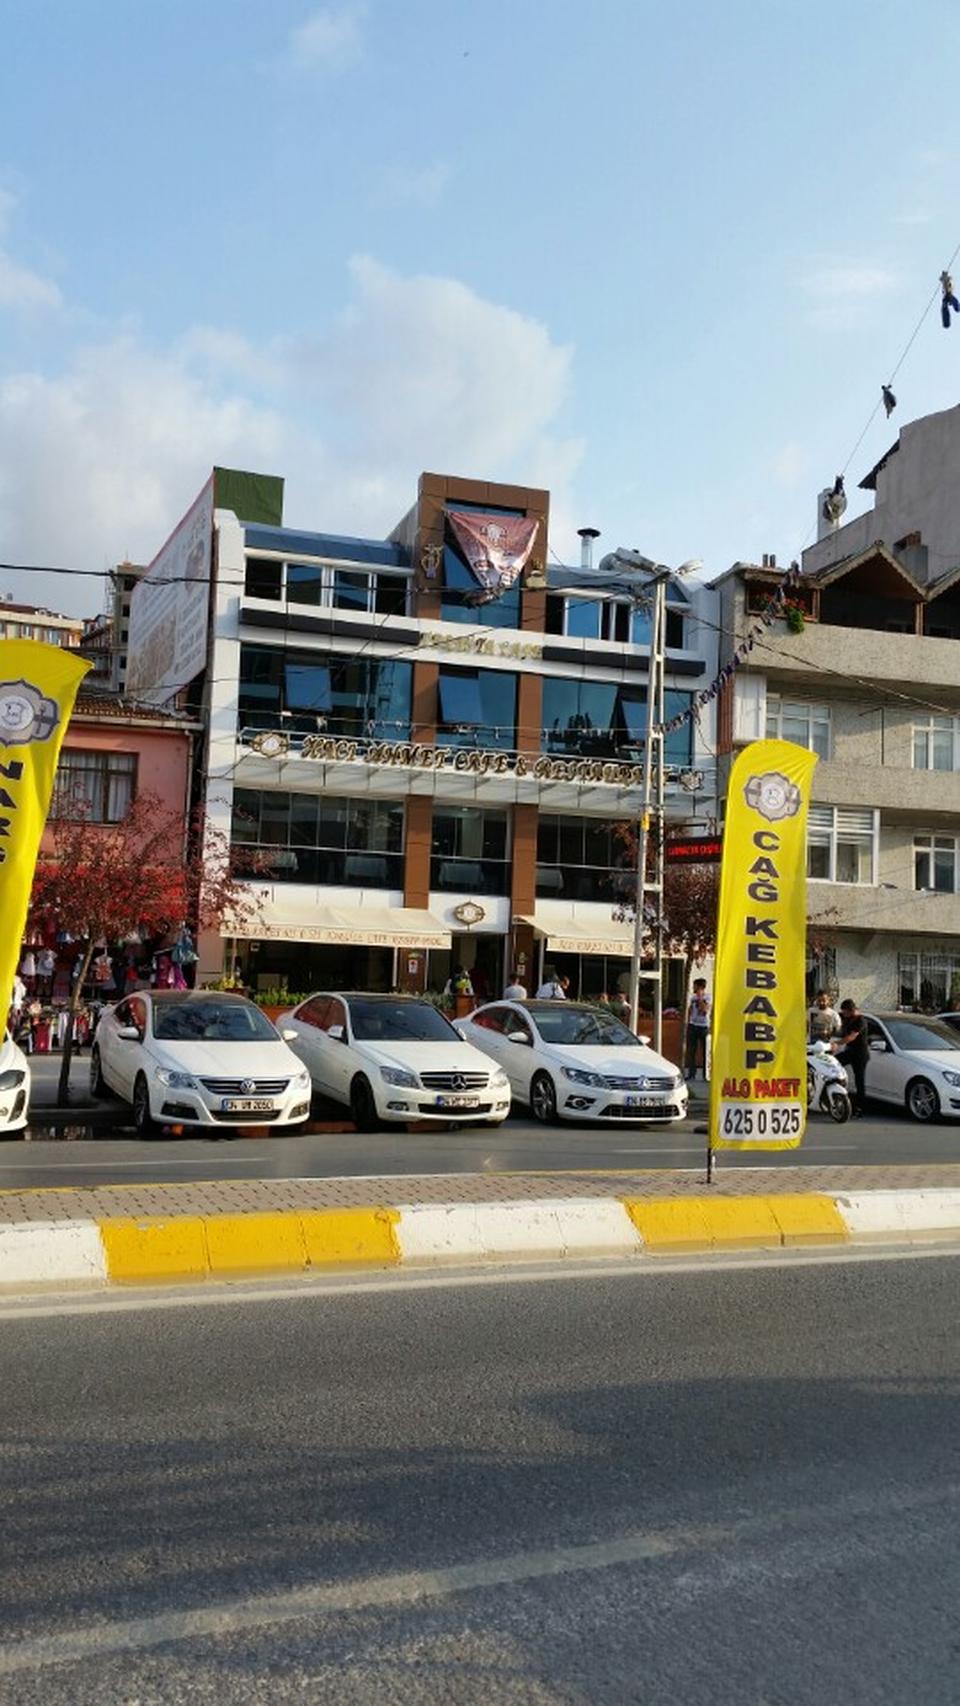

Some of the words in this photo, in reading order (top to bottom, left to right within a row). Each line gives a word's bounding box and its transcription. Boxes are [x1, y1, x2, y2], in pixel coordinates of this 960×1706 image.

[364, 742, 450, 769] AHMET
[453, 749, 508, 775] CAFE
[513, 755, 528, 777] &
[721, 1078, 750, 1098] ALO
[754, 1077, 800, 1098] PAKET
[723, 1108, 753, 1135] 625
[758, 1109, 767, 1134] 0
[771, 1108, 800, 1133] 525
